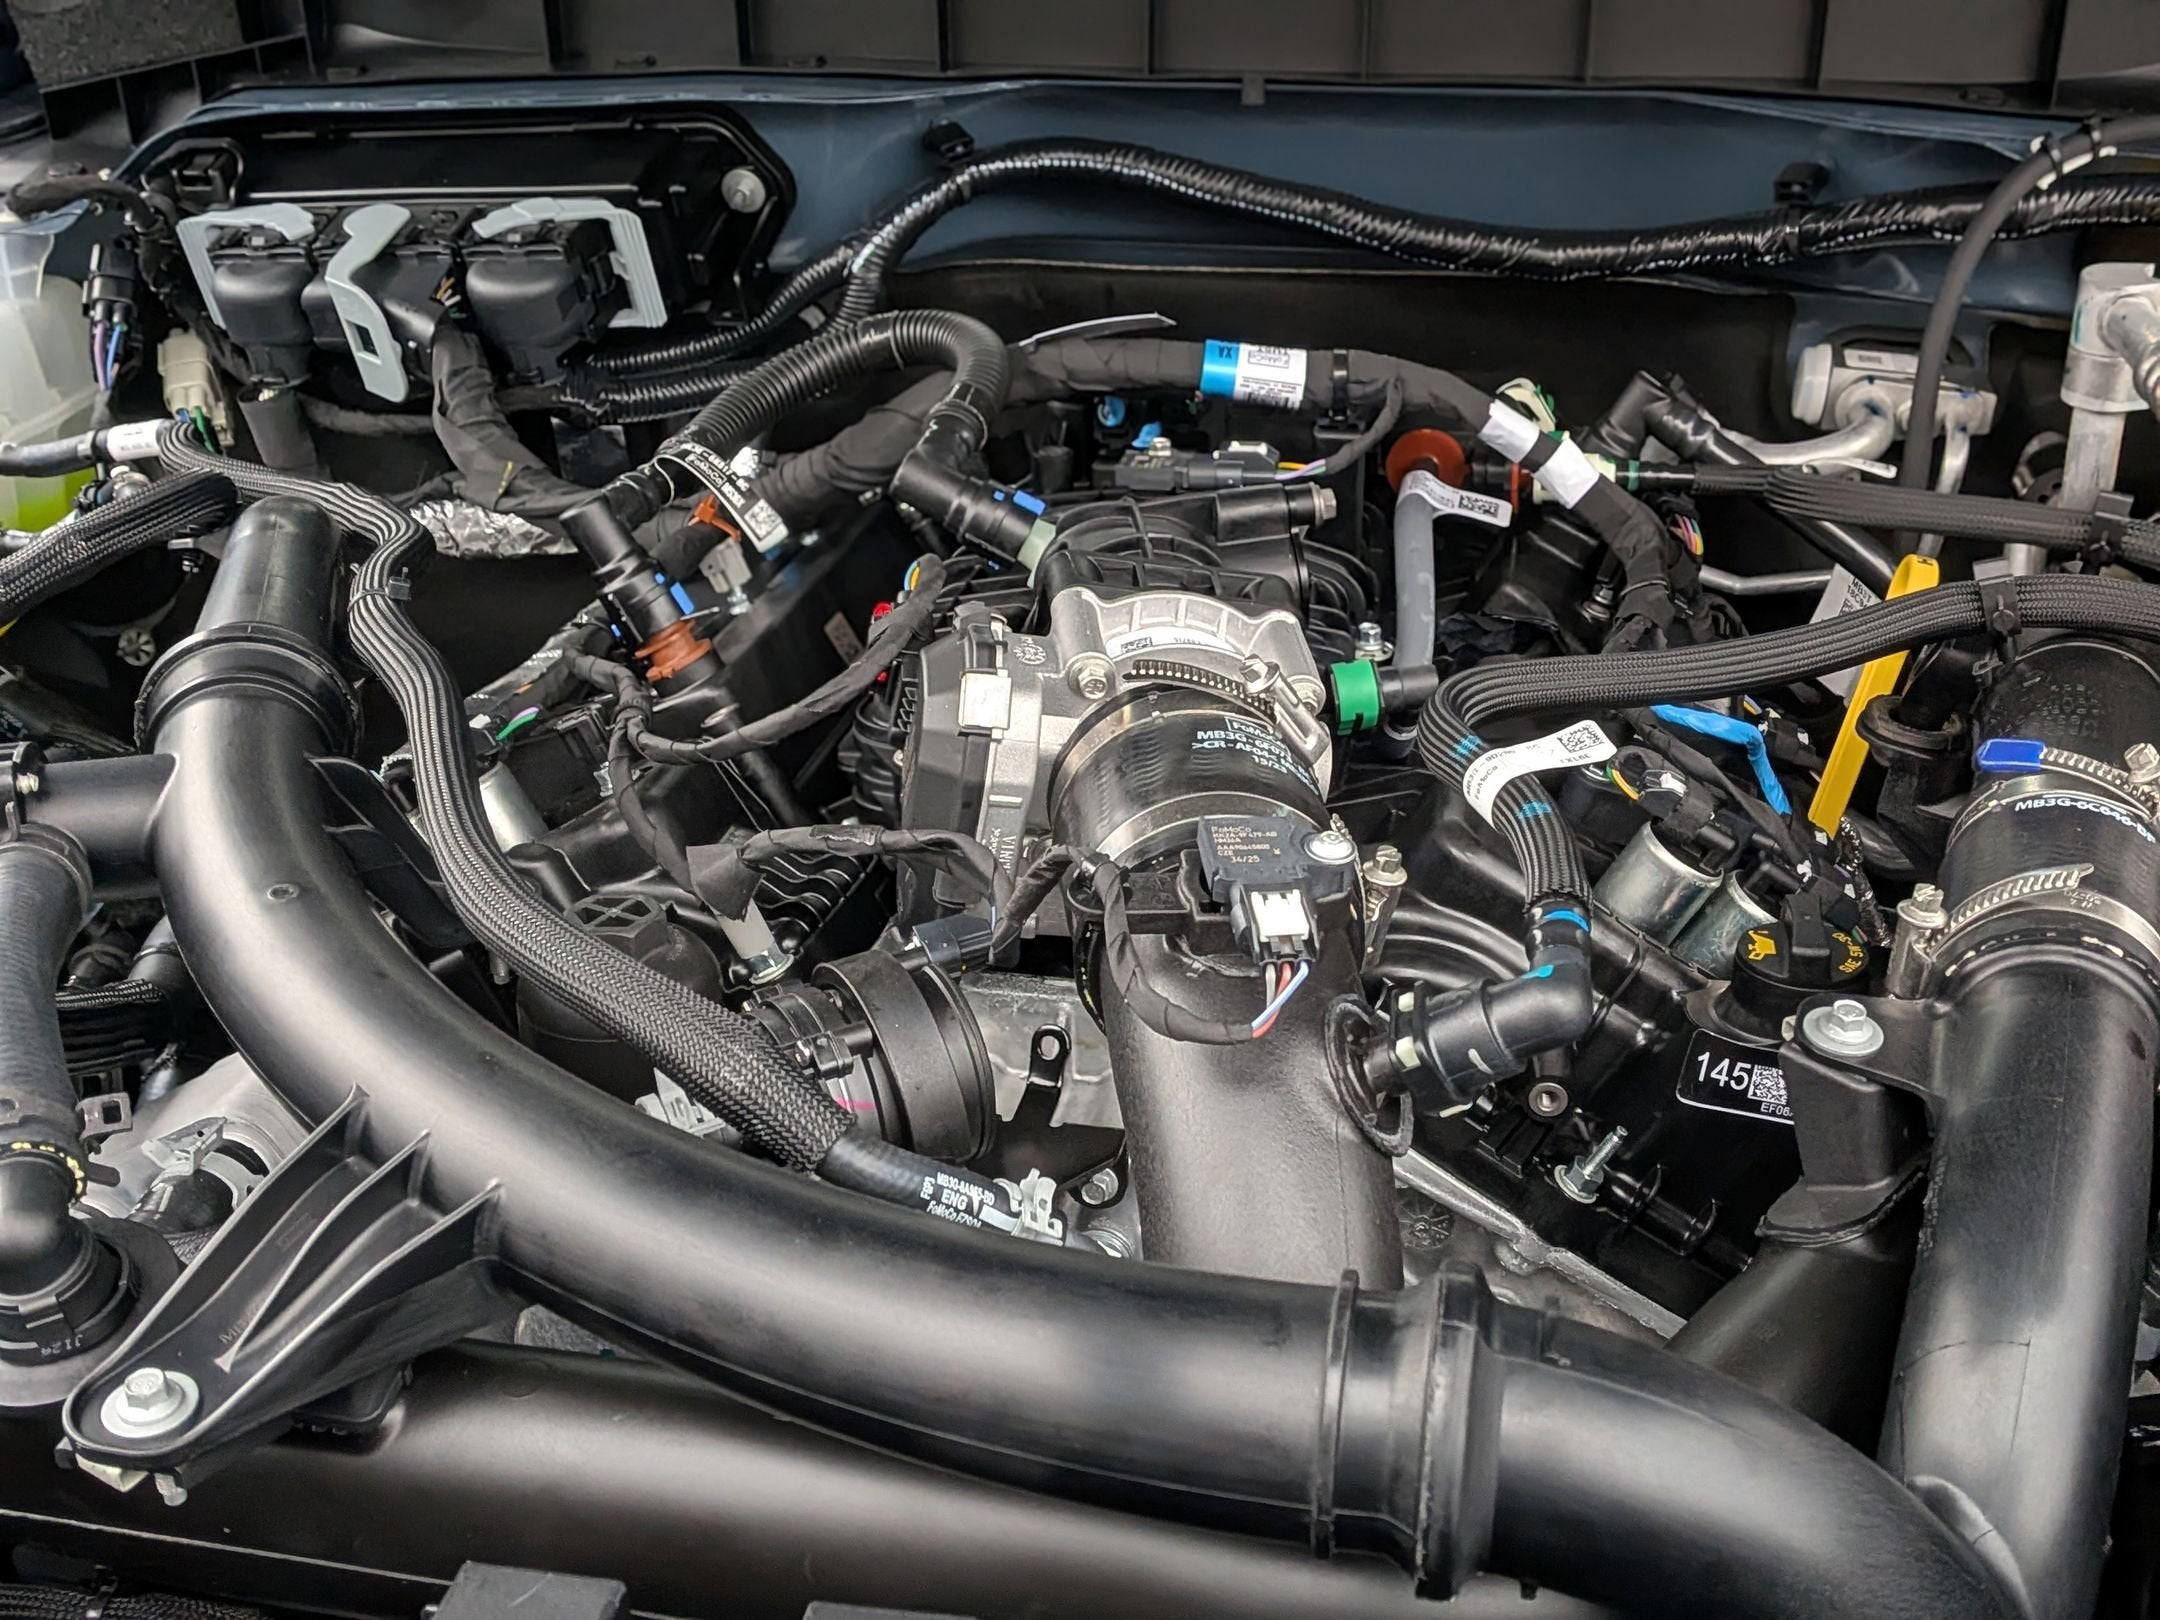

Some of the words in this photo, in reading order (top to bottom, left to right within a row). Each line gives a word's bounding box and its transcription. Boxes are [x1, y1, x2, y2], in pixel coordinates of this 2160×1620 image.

[1697, 1051, 1752, 1091] 145
[1760, 1102, 1794, 1117] EF06
[941, 1188, 968, 1211] ENG
